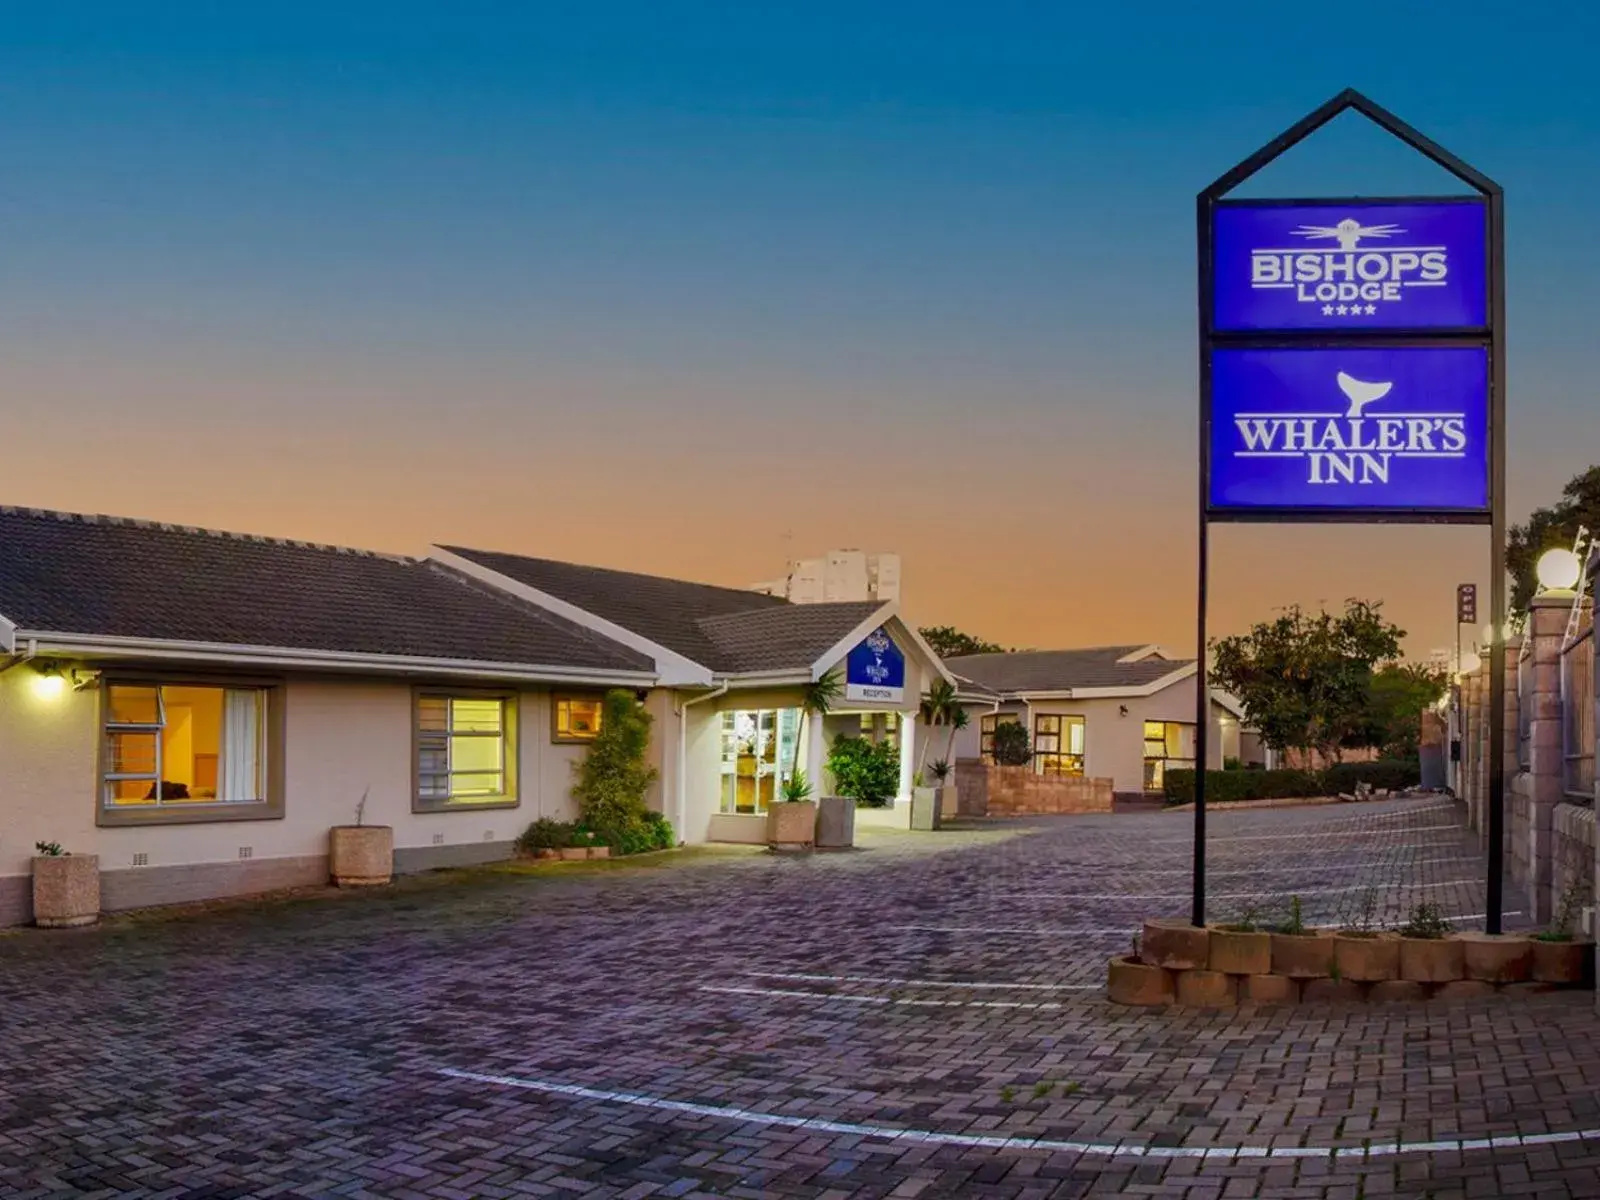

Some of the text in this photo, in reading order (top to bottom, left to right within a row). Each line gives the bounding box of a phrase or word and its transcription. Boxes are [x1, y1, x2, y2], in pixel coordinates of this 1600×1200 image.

[1251, 251, 1448, 282] BISHOPS
[1297, 281, 1402, 302] LODGE
[1234, 418, 1467, 452] WHALER'S
[1307, 452, 1393, 484] INN
